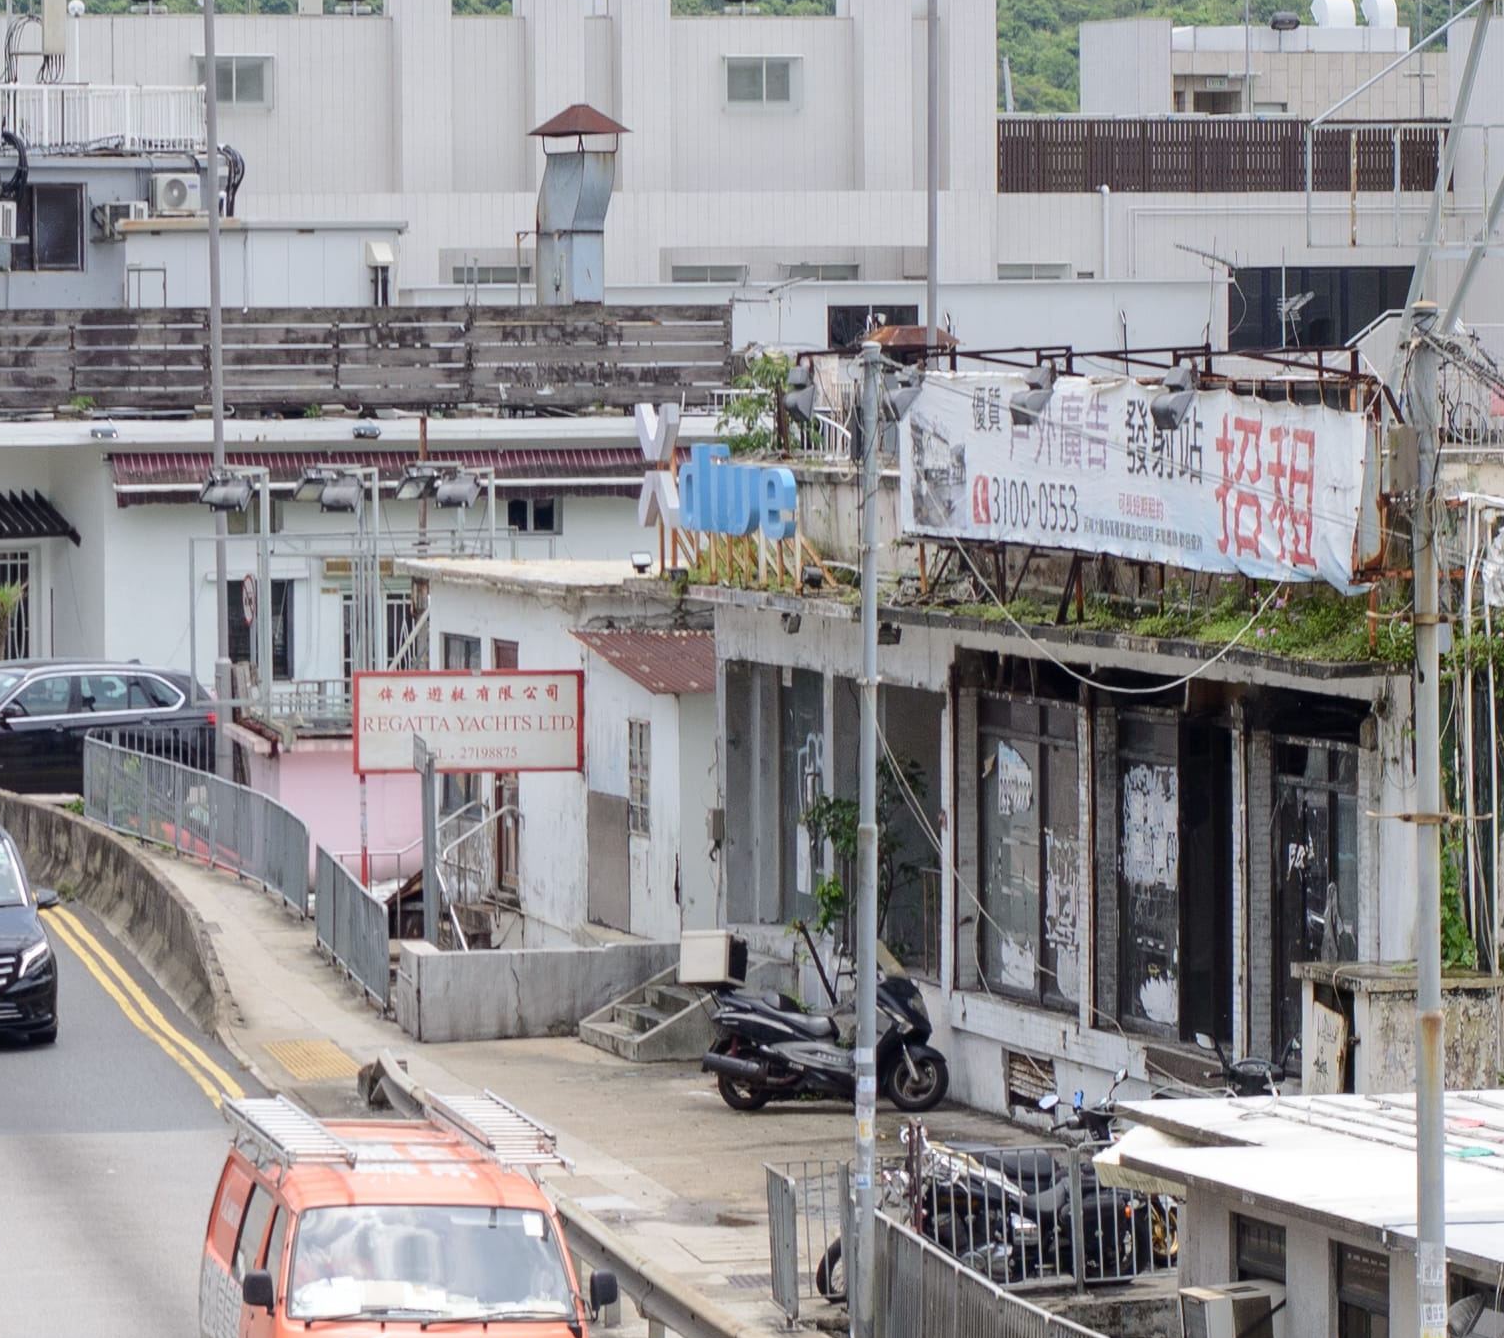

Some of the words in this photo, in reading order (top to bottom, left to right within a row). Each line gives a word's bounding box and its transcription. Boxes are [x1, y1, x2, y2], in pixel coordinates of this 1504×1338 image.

[971, 386, 1002, 432] 優質
[1216, 414, 1317, 570] 招租
[363, 716, 450, 732] REGATTA
[455, 716, 532, 732] YACHTS
[538, 715, 577, 732] LTD.
[460, 746, 518, 760] 27198875
